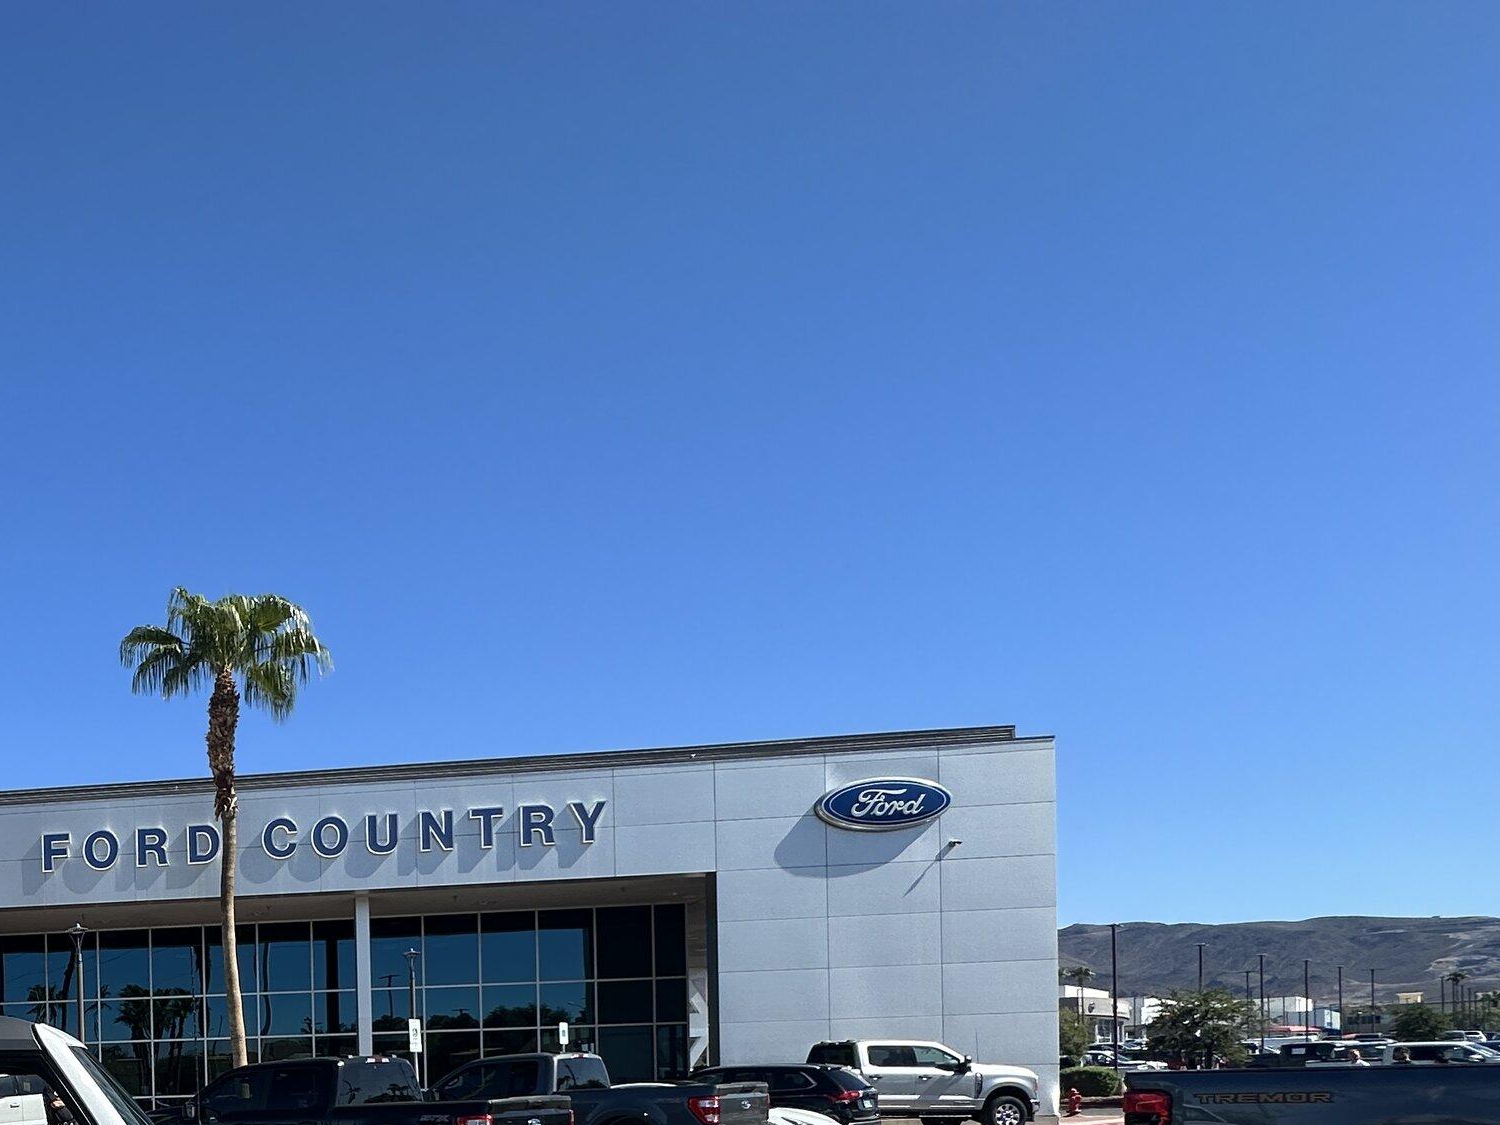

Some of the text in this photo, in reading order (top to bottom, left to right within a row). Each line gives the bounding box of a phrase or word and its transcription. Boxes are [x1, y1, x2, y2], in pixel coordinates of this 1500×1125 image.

[851, 788, 926, 817] Ford
[41, 799, 607, 873] FORD COUNTRY
[1194, 1091, 1334, 1105] TREMOR
